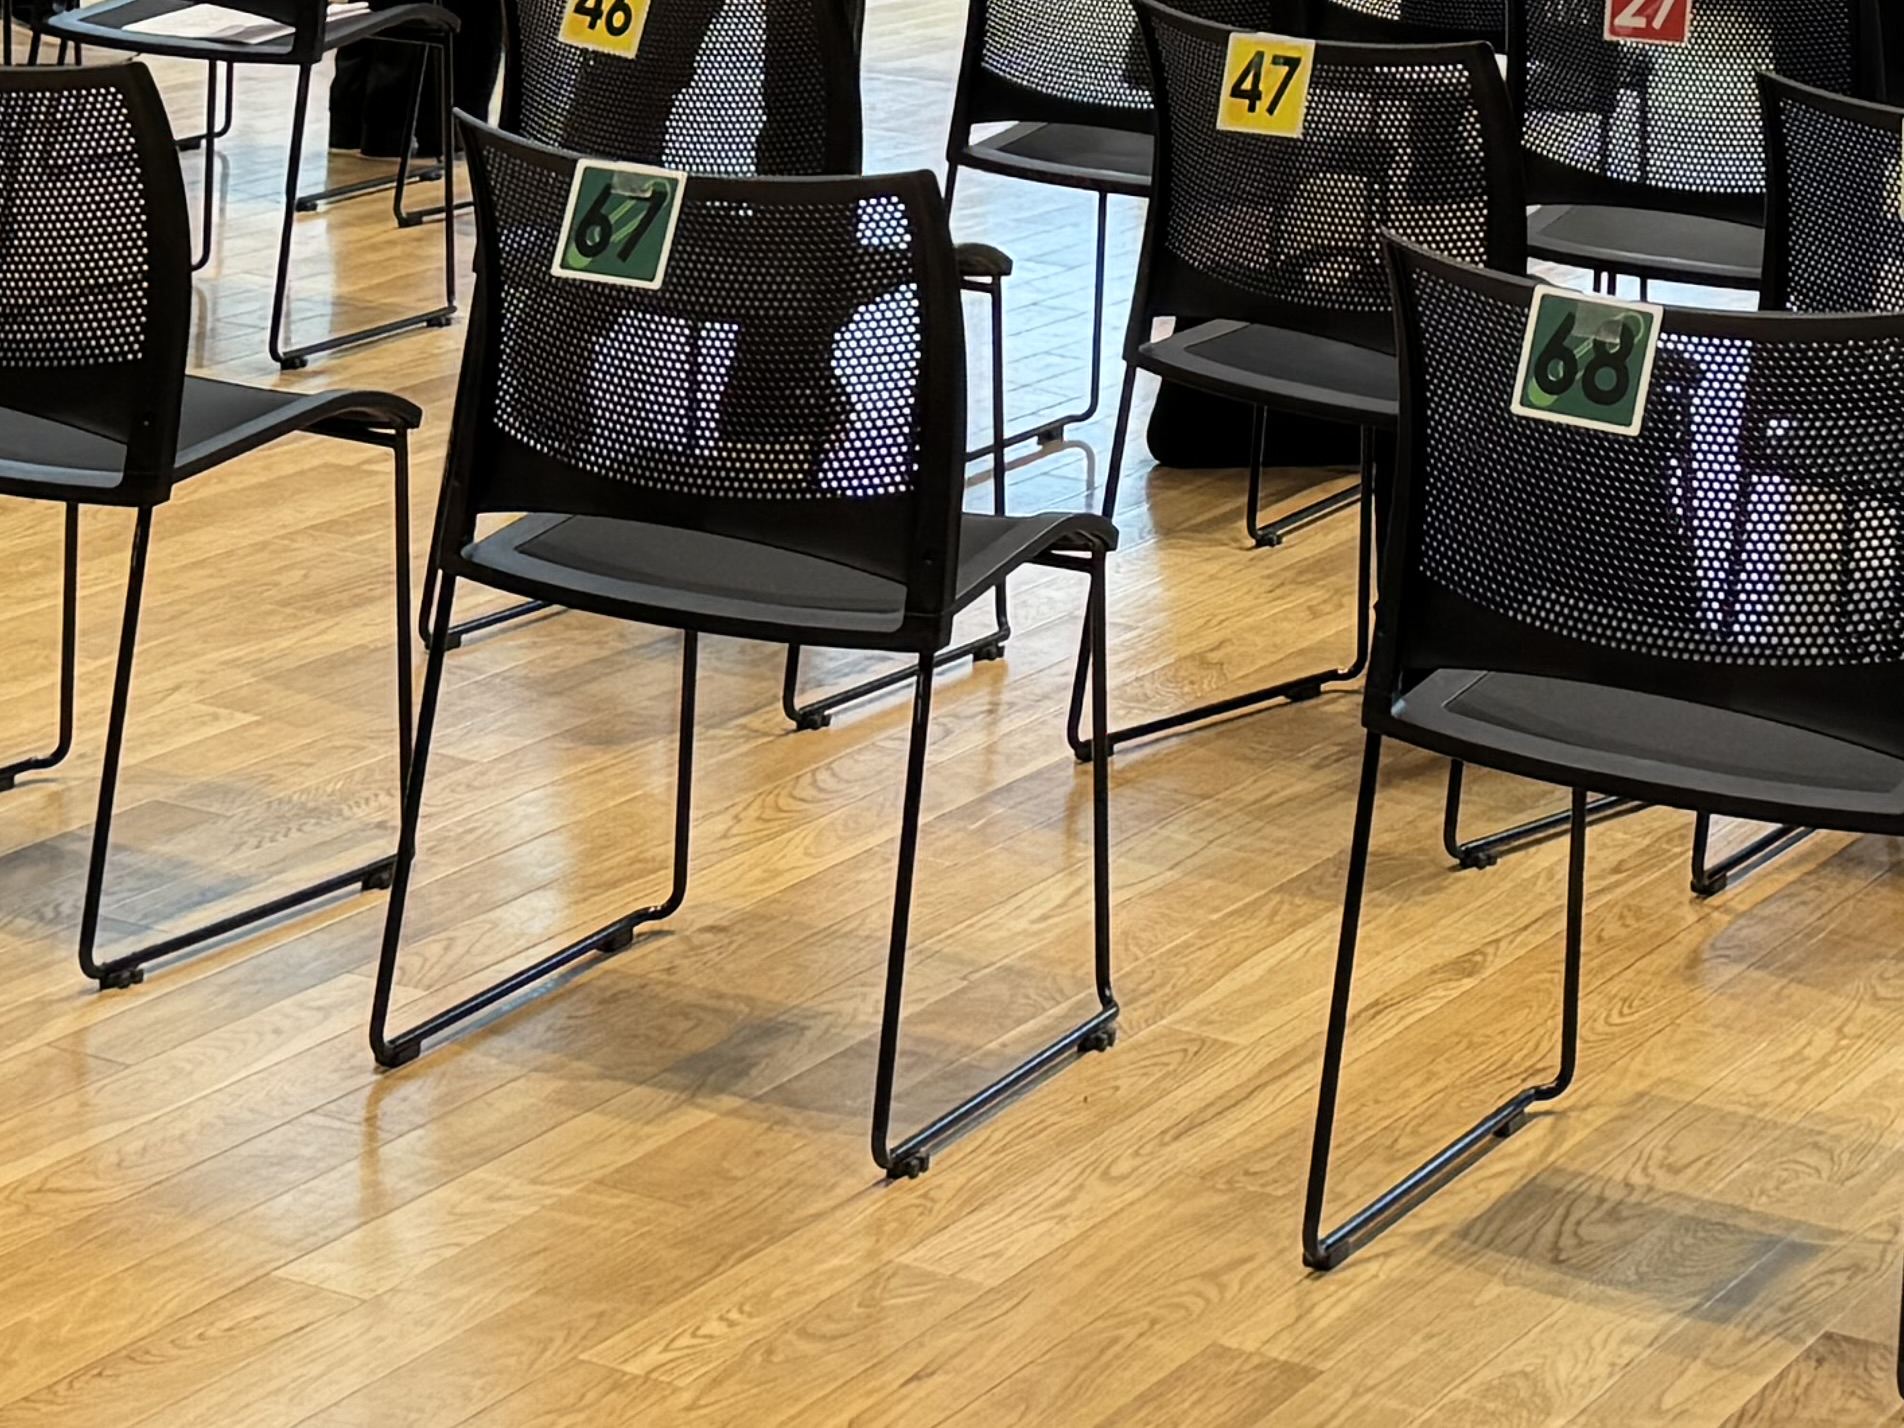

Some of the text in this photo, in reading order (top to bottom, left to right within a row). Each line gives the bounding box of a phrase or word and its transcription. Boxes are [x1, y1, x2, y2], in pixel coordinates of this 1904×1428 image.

[1229, 49, 1302, 117] 47
[573, 179, 671, 263] 67
[1534, 309, 1636, 407] 68
